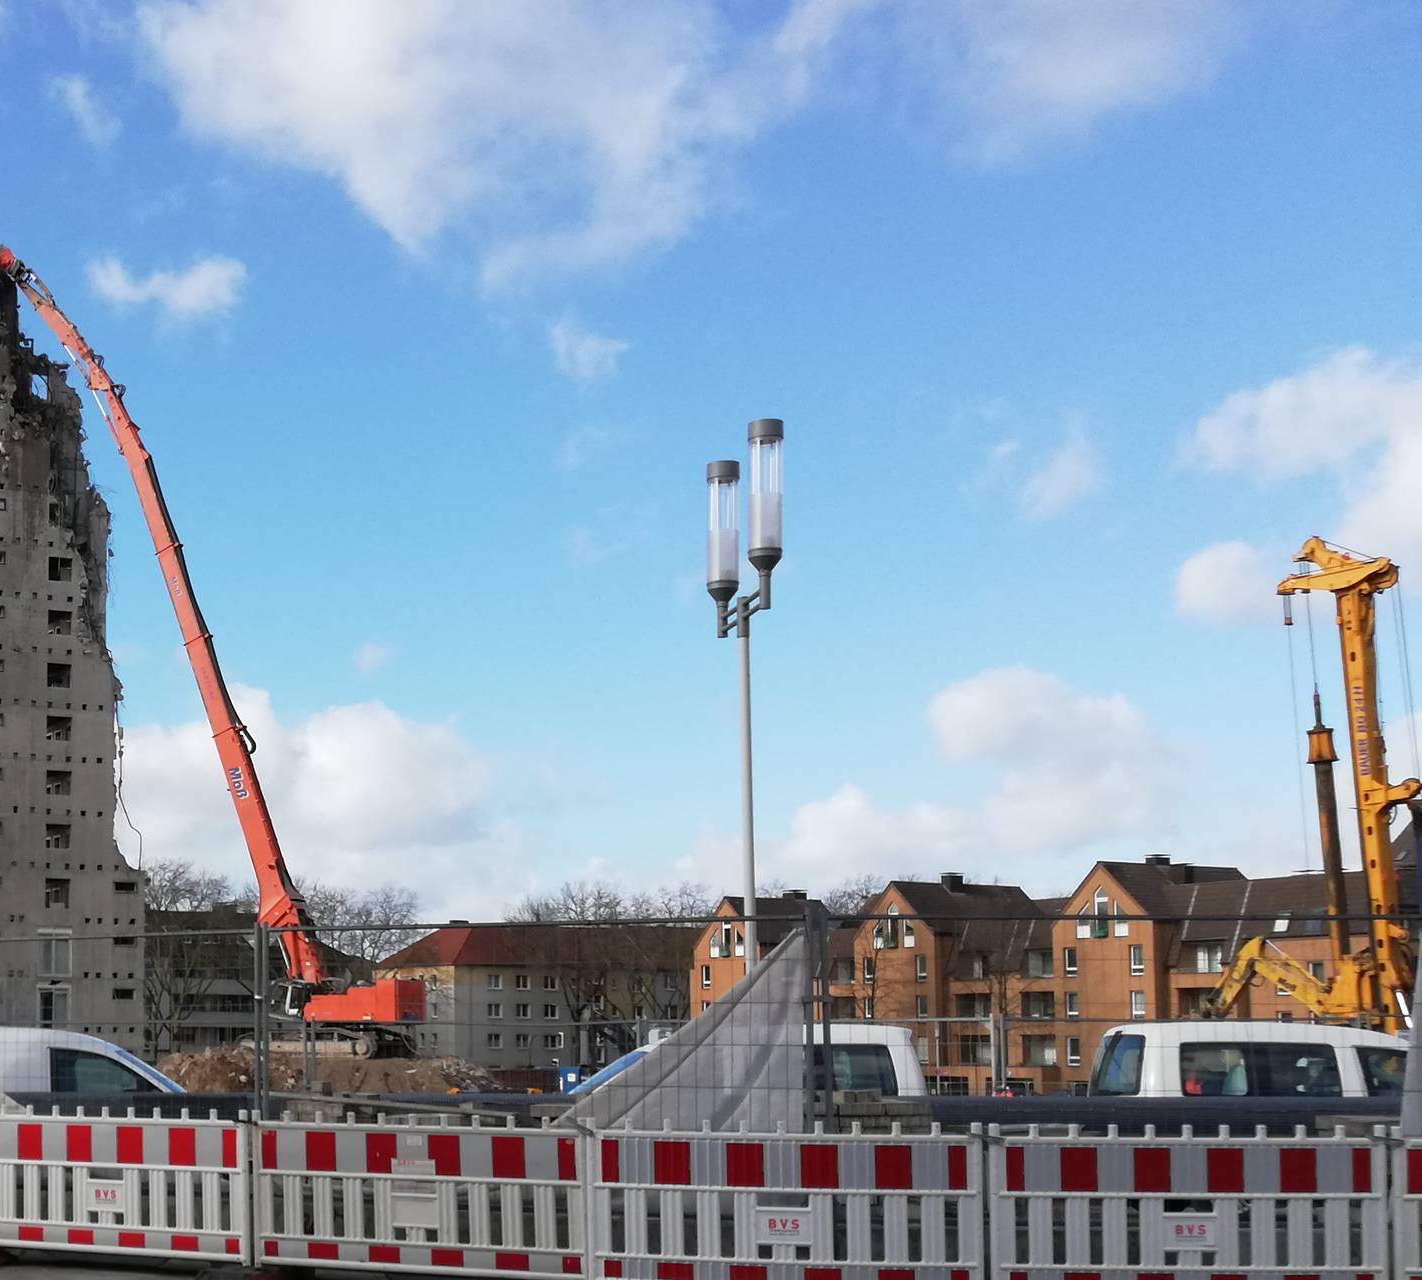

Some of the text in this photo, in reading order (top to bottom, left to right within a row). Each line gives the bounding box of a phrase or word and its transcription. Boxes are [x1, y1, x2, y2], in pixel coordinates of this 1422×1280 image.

[229, 767, 248, 800] Moß
[95, 1189, 116, 1200] BVS
[769, 1218, 800, 1230] BVS
[1175, 1224, 1207, 1235] BVS
